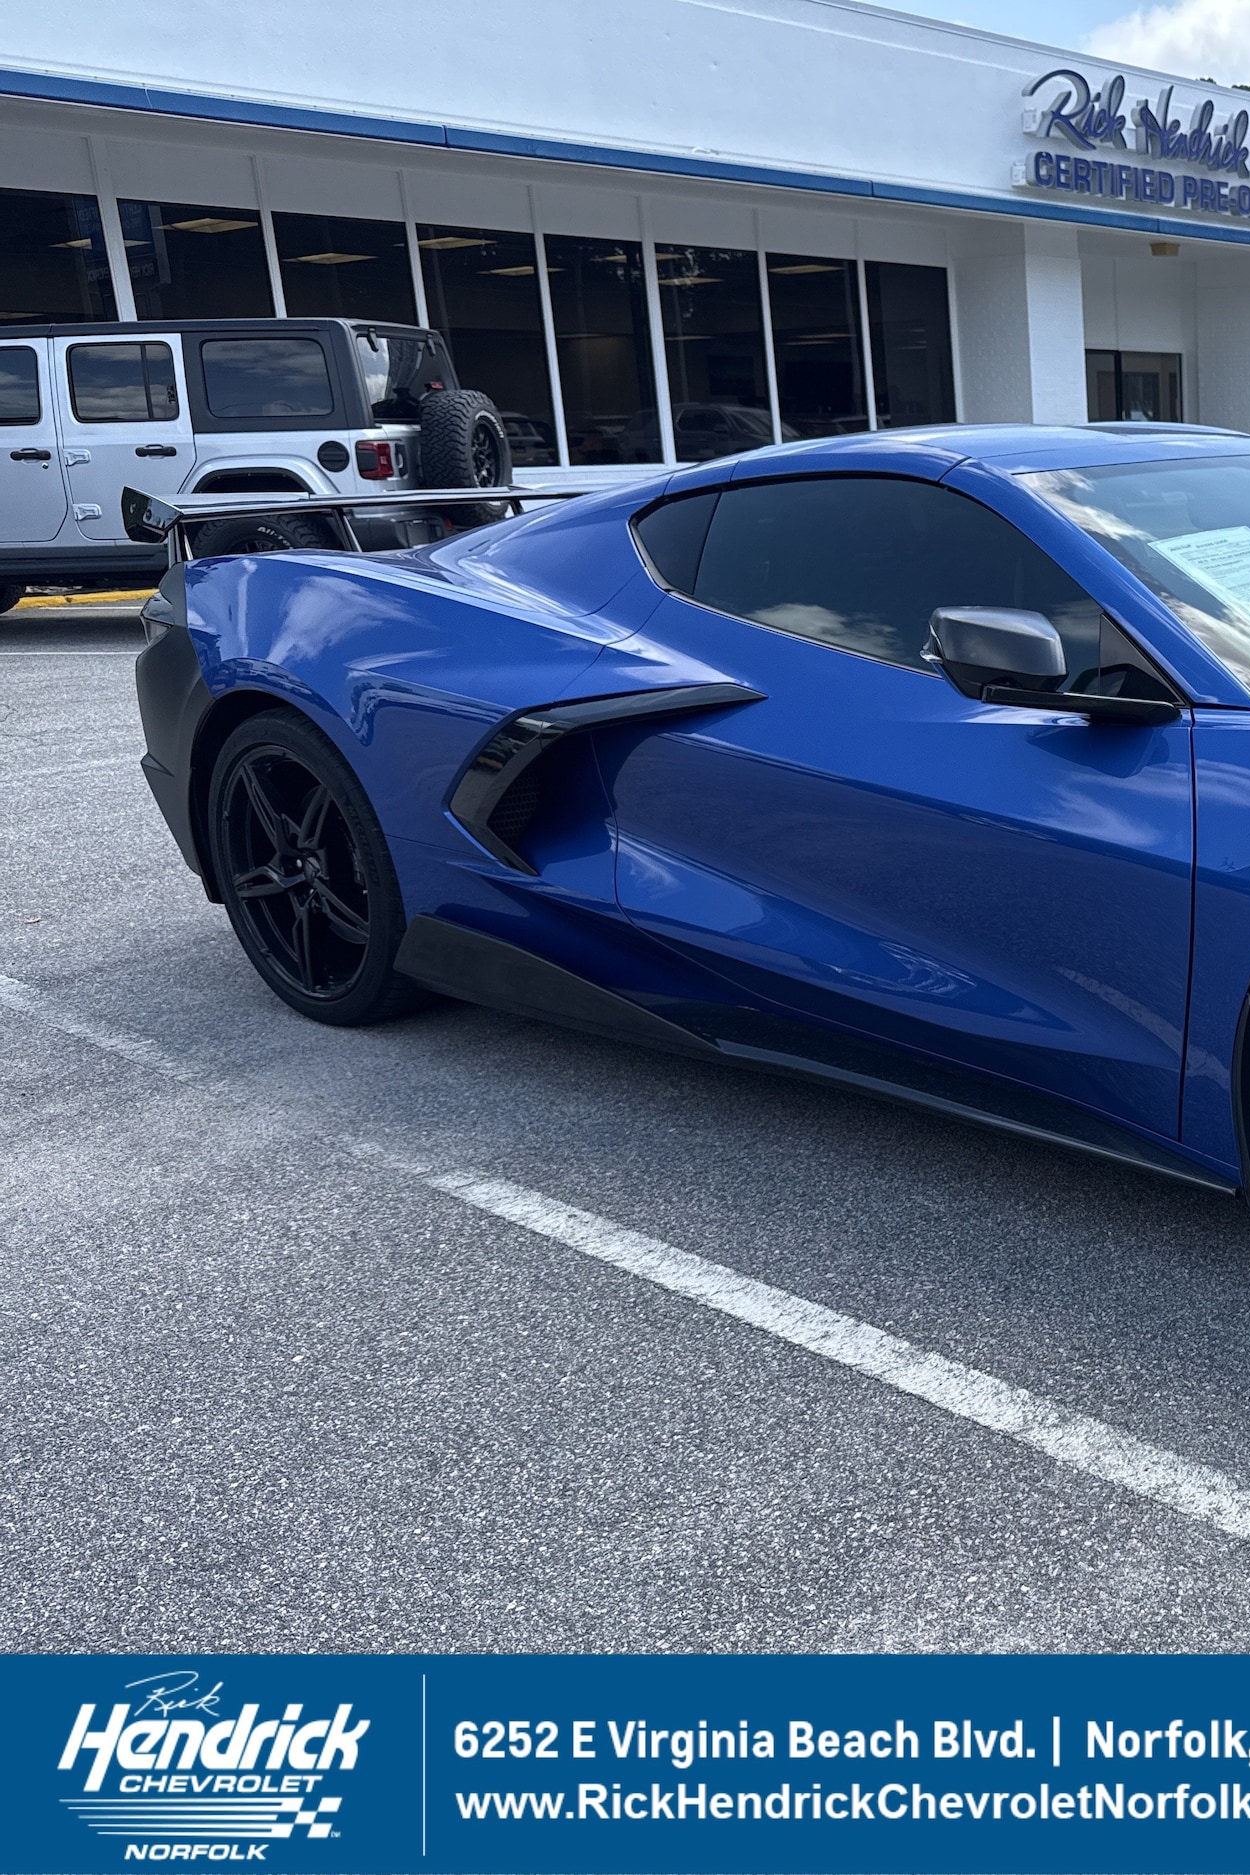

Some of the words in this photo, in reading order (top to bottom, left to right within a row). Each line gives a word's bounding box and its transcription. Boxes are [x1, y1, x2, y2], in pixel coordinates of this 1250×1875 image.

[1022, 69, 1128, 151] Rick
[1131, 85, 1250, 178] Hendrick
[1027, 151, 1175, 207] CERTIFIED
